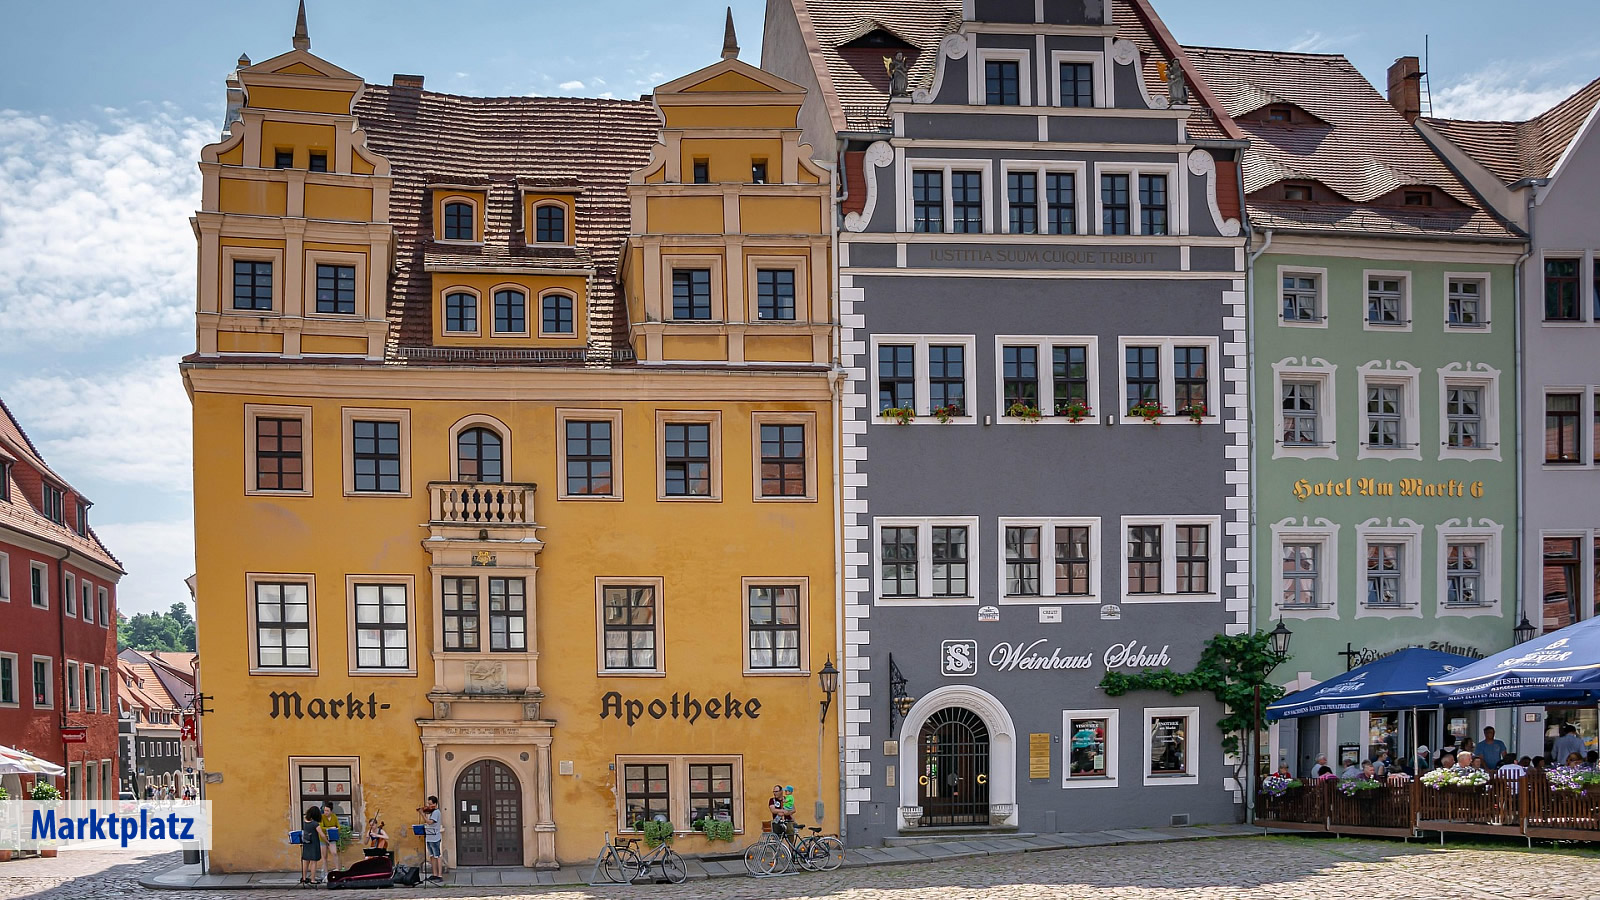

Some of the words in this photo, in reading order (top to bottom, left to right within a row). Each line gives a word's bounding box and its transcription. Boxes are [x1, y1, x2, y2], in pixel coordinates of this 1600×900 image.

[929, 249, 993, 262] IUSTITIA
[996, 250, 1040, 263] SUUM
[1042, 250, 1095, 265] CUIQUE
[1099, 251, 1158, 265] TRIBUIT
[1293, 478, 1352, 502] Hotel
[1357, 478, 1394, 497] Am
[1399, 478, 1465, 498] Markt
[989, 639, 1093, 672] Weinhaus
[1104, 640, 1171, 671] Schuh
[269, 690, 391, 719] Markt-
[599, 691, 762, 727] Apotheke
